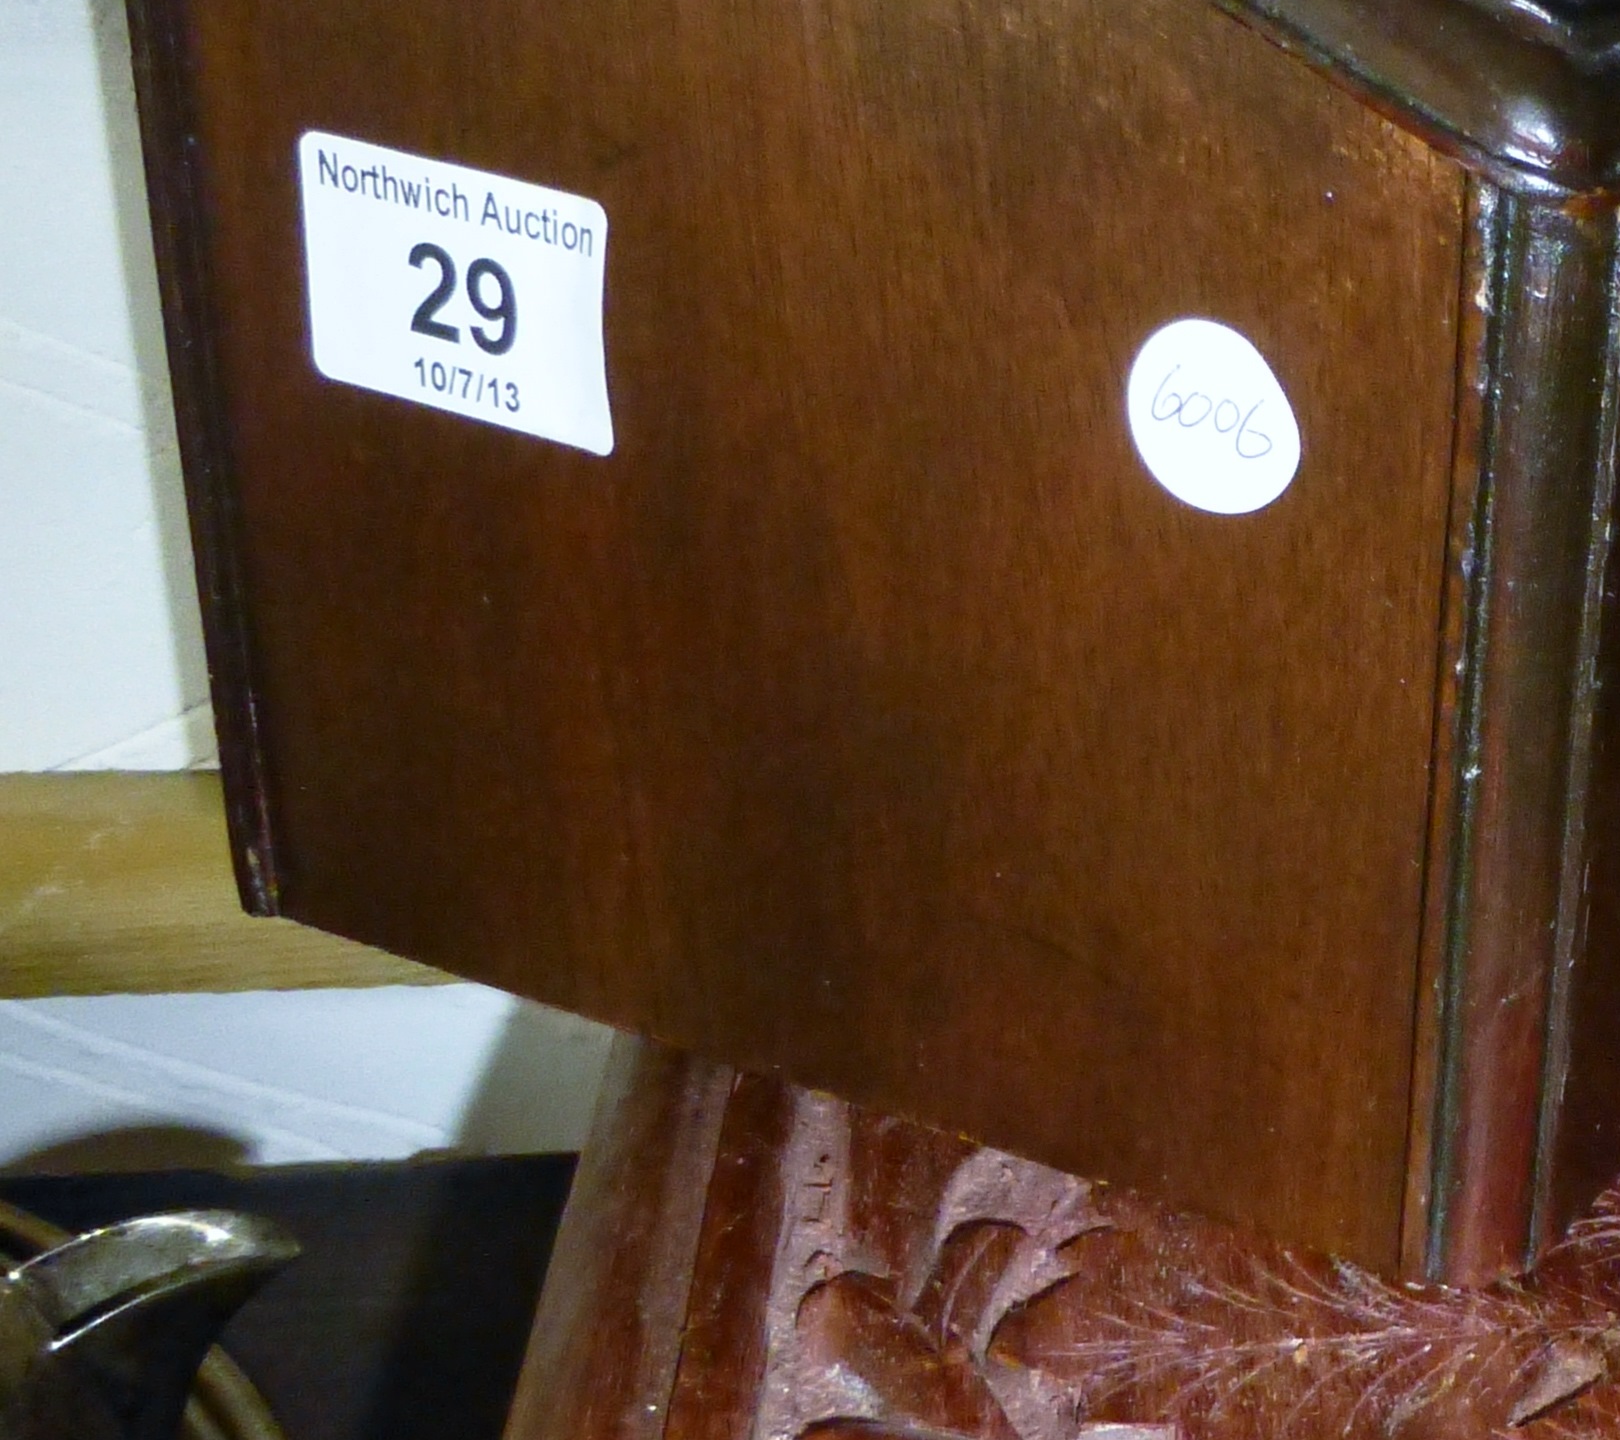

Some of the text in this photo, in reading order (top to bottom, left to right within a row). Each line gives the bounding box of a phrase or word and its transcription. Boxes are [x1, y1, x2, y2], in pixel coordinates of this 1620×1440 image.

[317, 148, 593, 258] Northwich Auction
[408, 242, 518, 356] 29
[414, 357, 521, 413] 10/7/13
[1151, 363, 1273, 459] 6006
